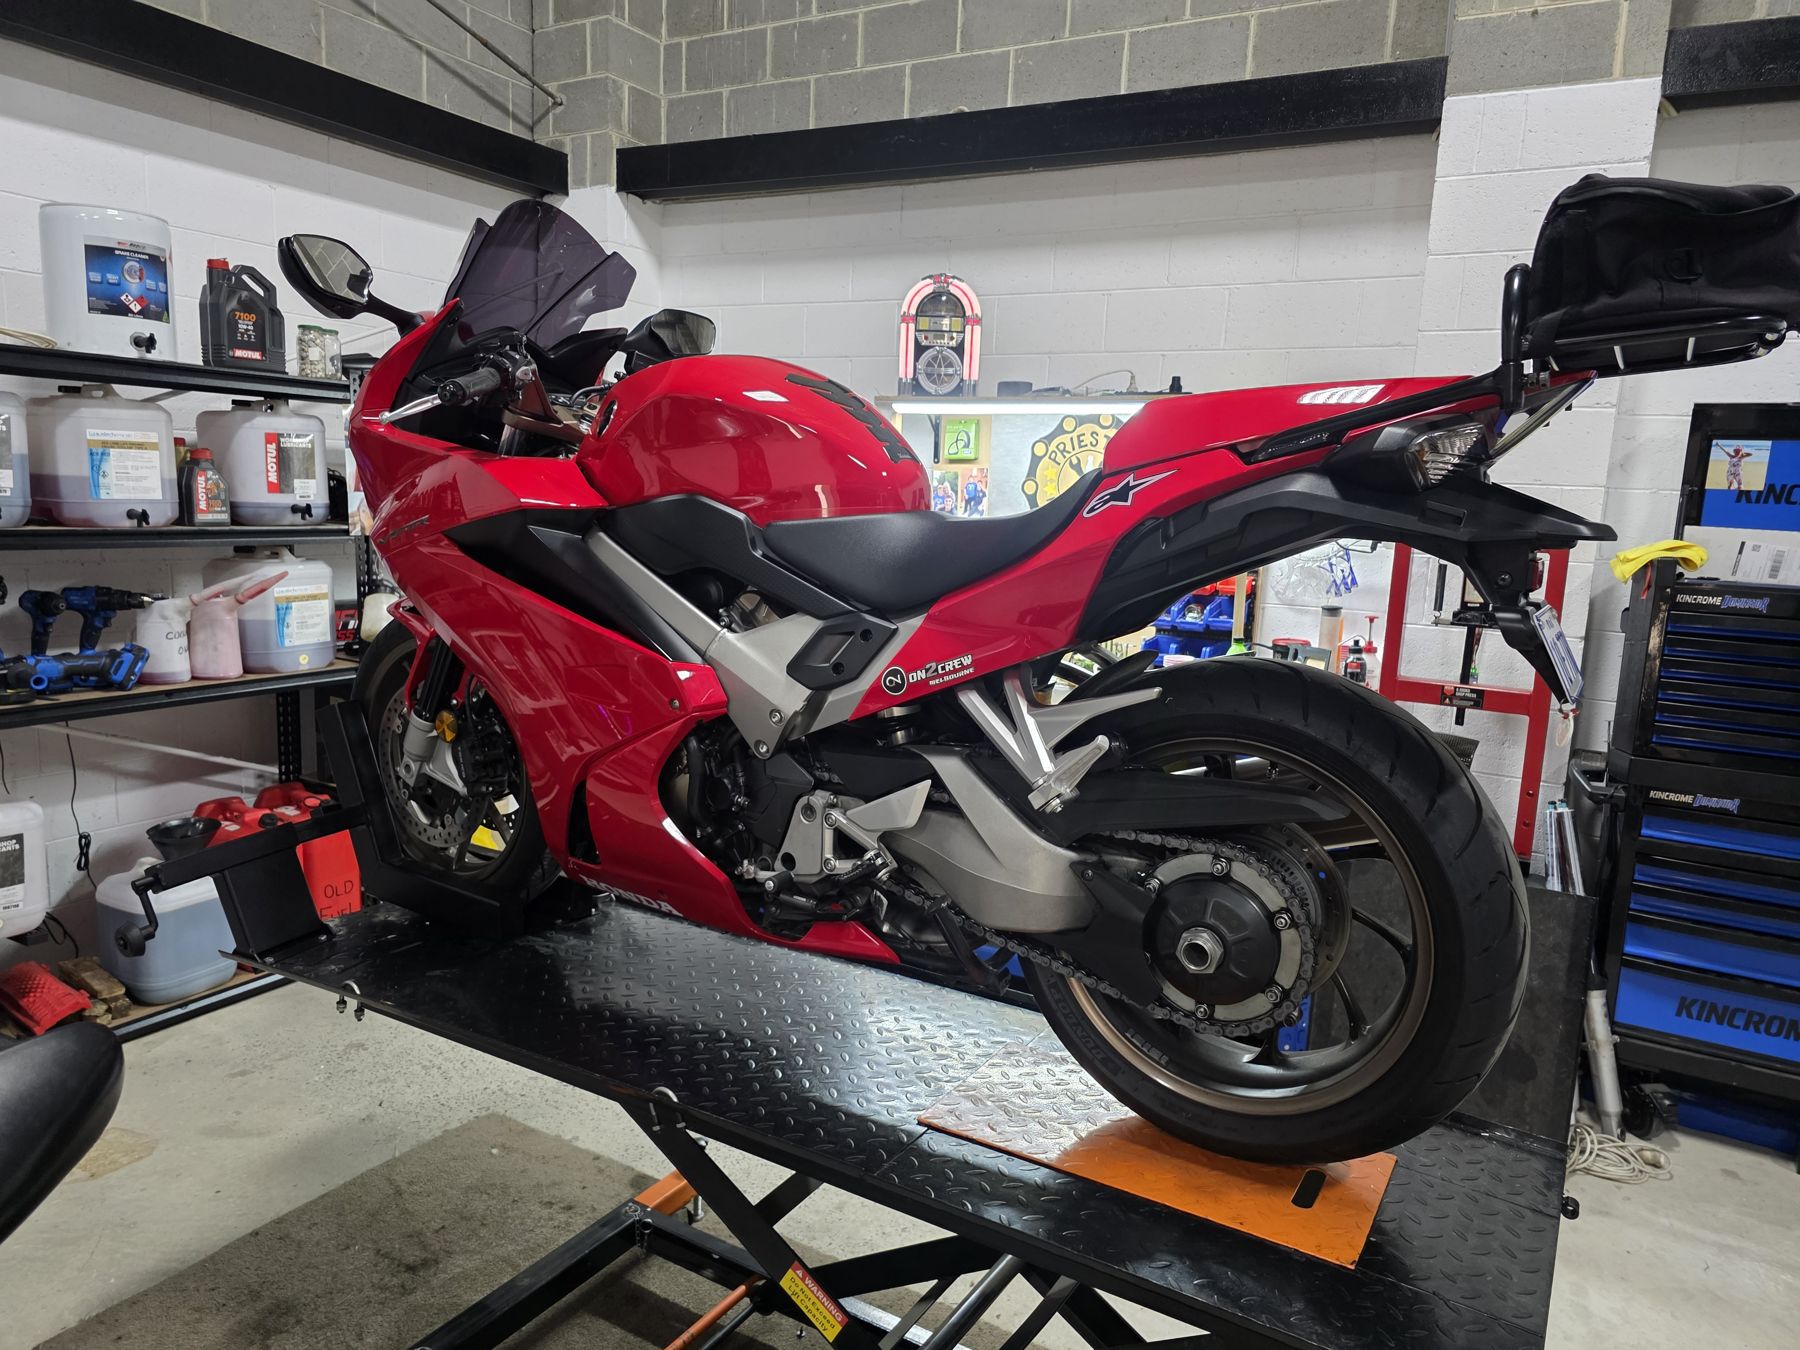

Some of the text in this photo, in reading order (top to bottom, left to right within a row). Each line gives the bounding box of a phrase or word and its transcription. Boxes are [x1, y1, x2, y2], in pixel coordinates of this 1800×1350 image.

[234, 311, 256, 322] 7100
[233, 348, 262, 360] MOTUL
[267, 442, 278, 484] MOTUL
[197, 475, 207, 510] MOTUL
[1676, 594, 1722, 605] KINCROME
[929, 667, 975, 686] MELBOURNE
[1649, 790, 1695, 803] KINCROME
[324, 880, 354, 898] OLD
[788, 1285, 829, 1332] Lift Capacity
[804, 1276, 843, 1322] WARNING
[811, 1301, 836, 1329] Exceed
